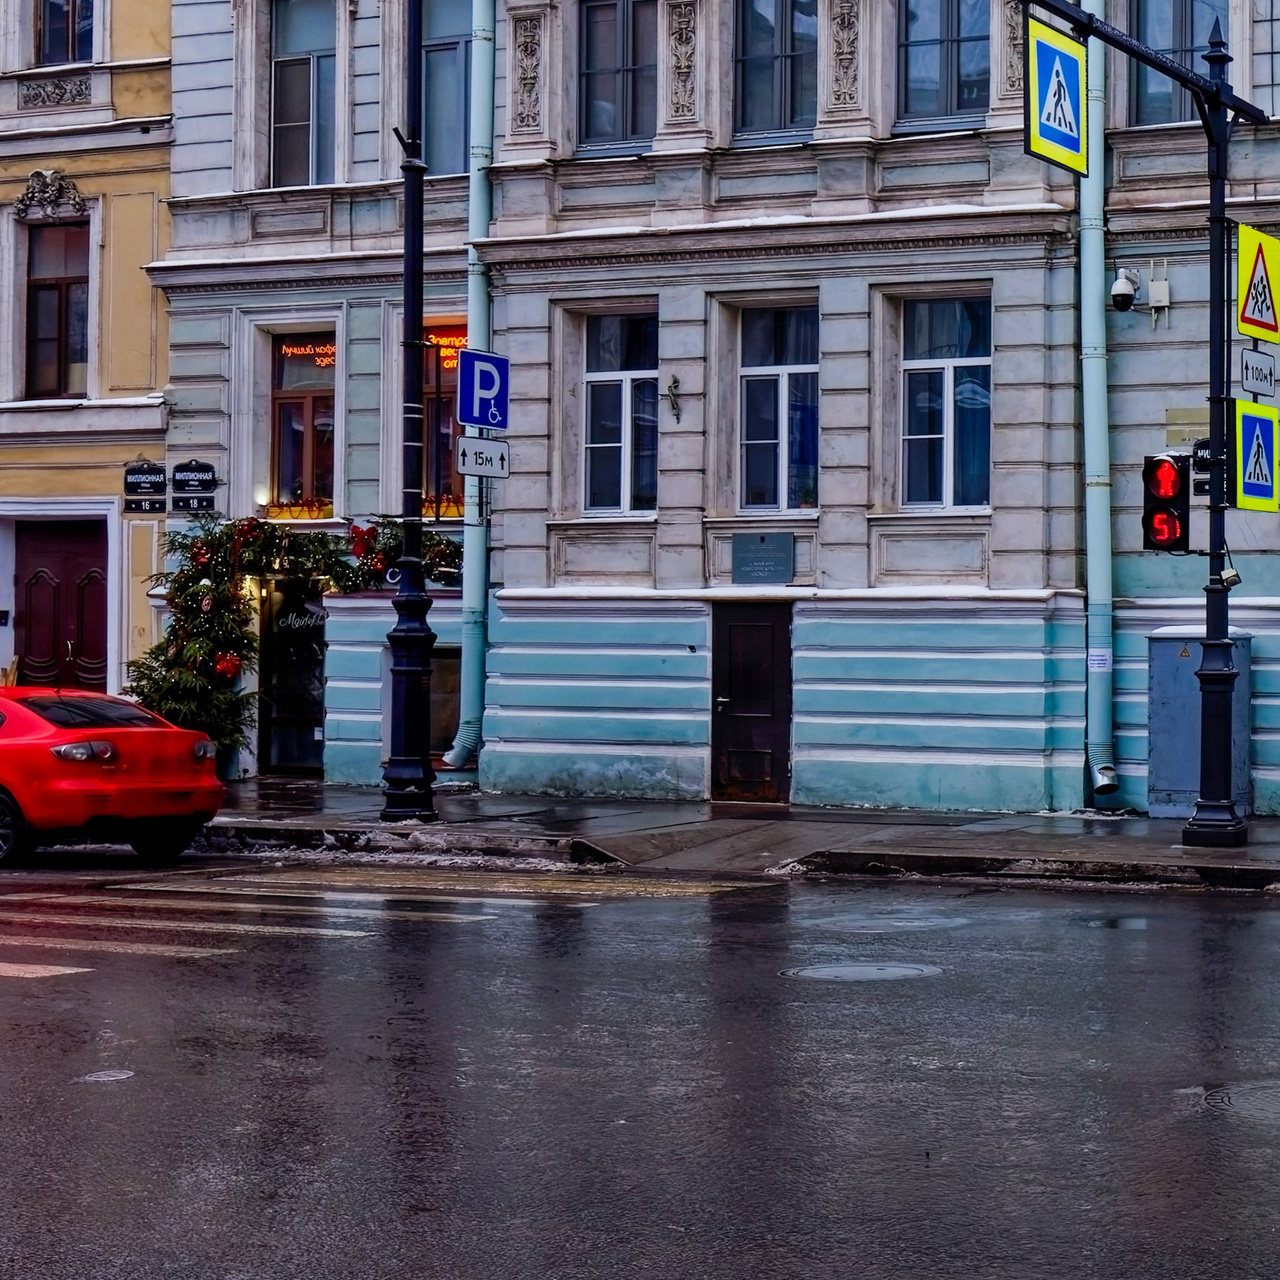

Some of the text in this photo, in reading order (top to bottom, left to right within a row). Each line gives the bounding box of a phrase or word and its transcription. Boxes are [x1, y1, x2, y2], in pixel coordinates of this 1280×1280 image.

[282, 344, 315, 357] Лучший
[440, 347, 457, 357] вес
[314, 357, 336, 367] здес
[1251, 365, 1269, 384] 100м
[473, 360, 501, 418] P
[473, 451, 493, 467] 15м
[141, 501, 150, 510] 16
[189, 498, 198, 508] 18
